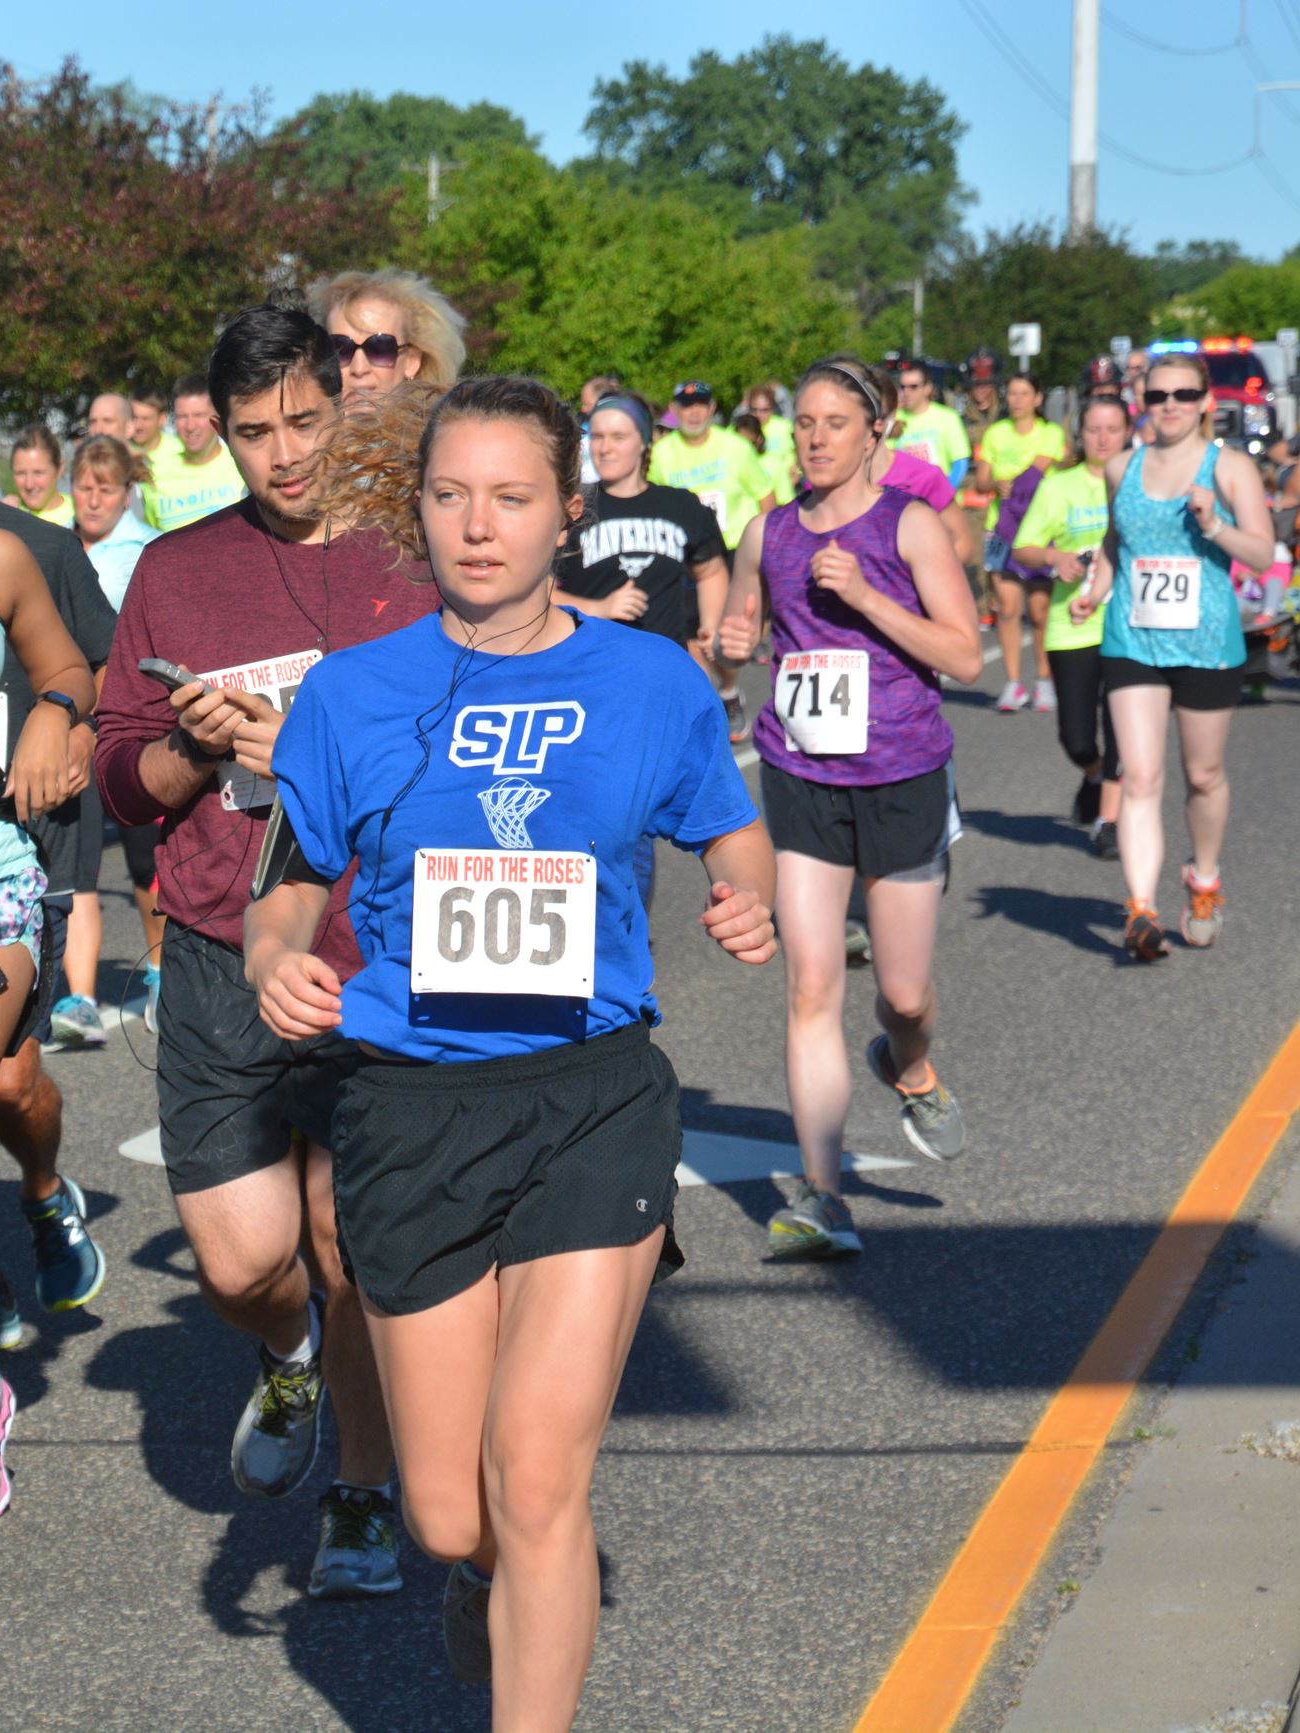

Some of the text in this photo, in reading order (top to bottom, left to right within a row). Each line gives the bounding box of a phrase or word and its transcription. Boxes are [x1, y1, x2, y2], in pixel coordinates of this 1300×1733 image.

[580, 518, 688, 569] MAVERICKS
[1141, 572, 1188, 602] 729
[222, 672, 247, 690] FOR
[248, 666, 273, 688] THE
[275, 655, 314, 683] ROSES
[814, 655, 828, 669] THE
[832, 655, 861, 669] ROSES
[787, 672, 851, 717] 714
[448, 701, 585, 775] SLP
[427, 856, 584, 884] RUN FOR THE ROSES
[437, 887, 567, 965] 605
